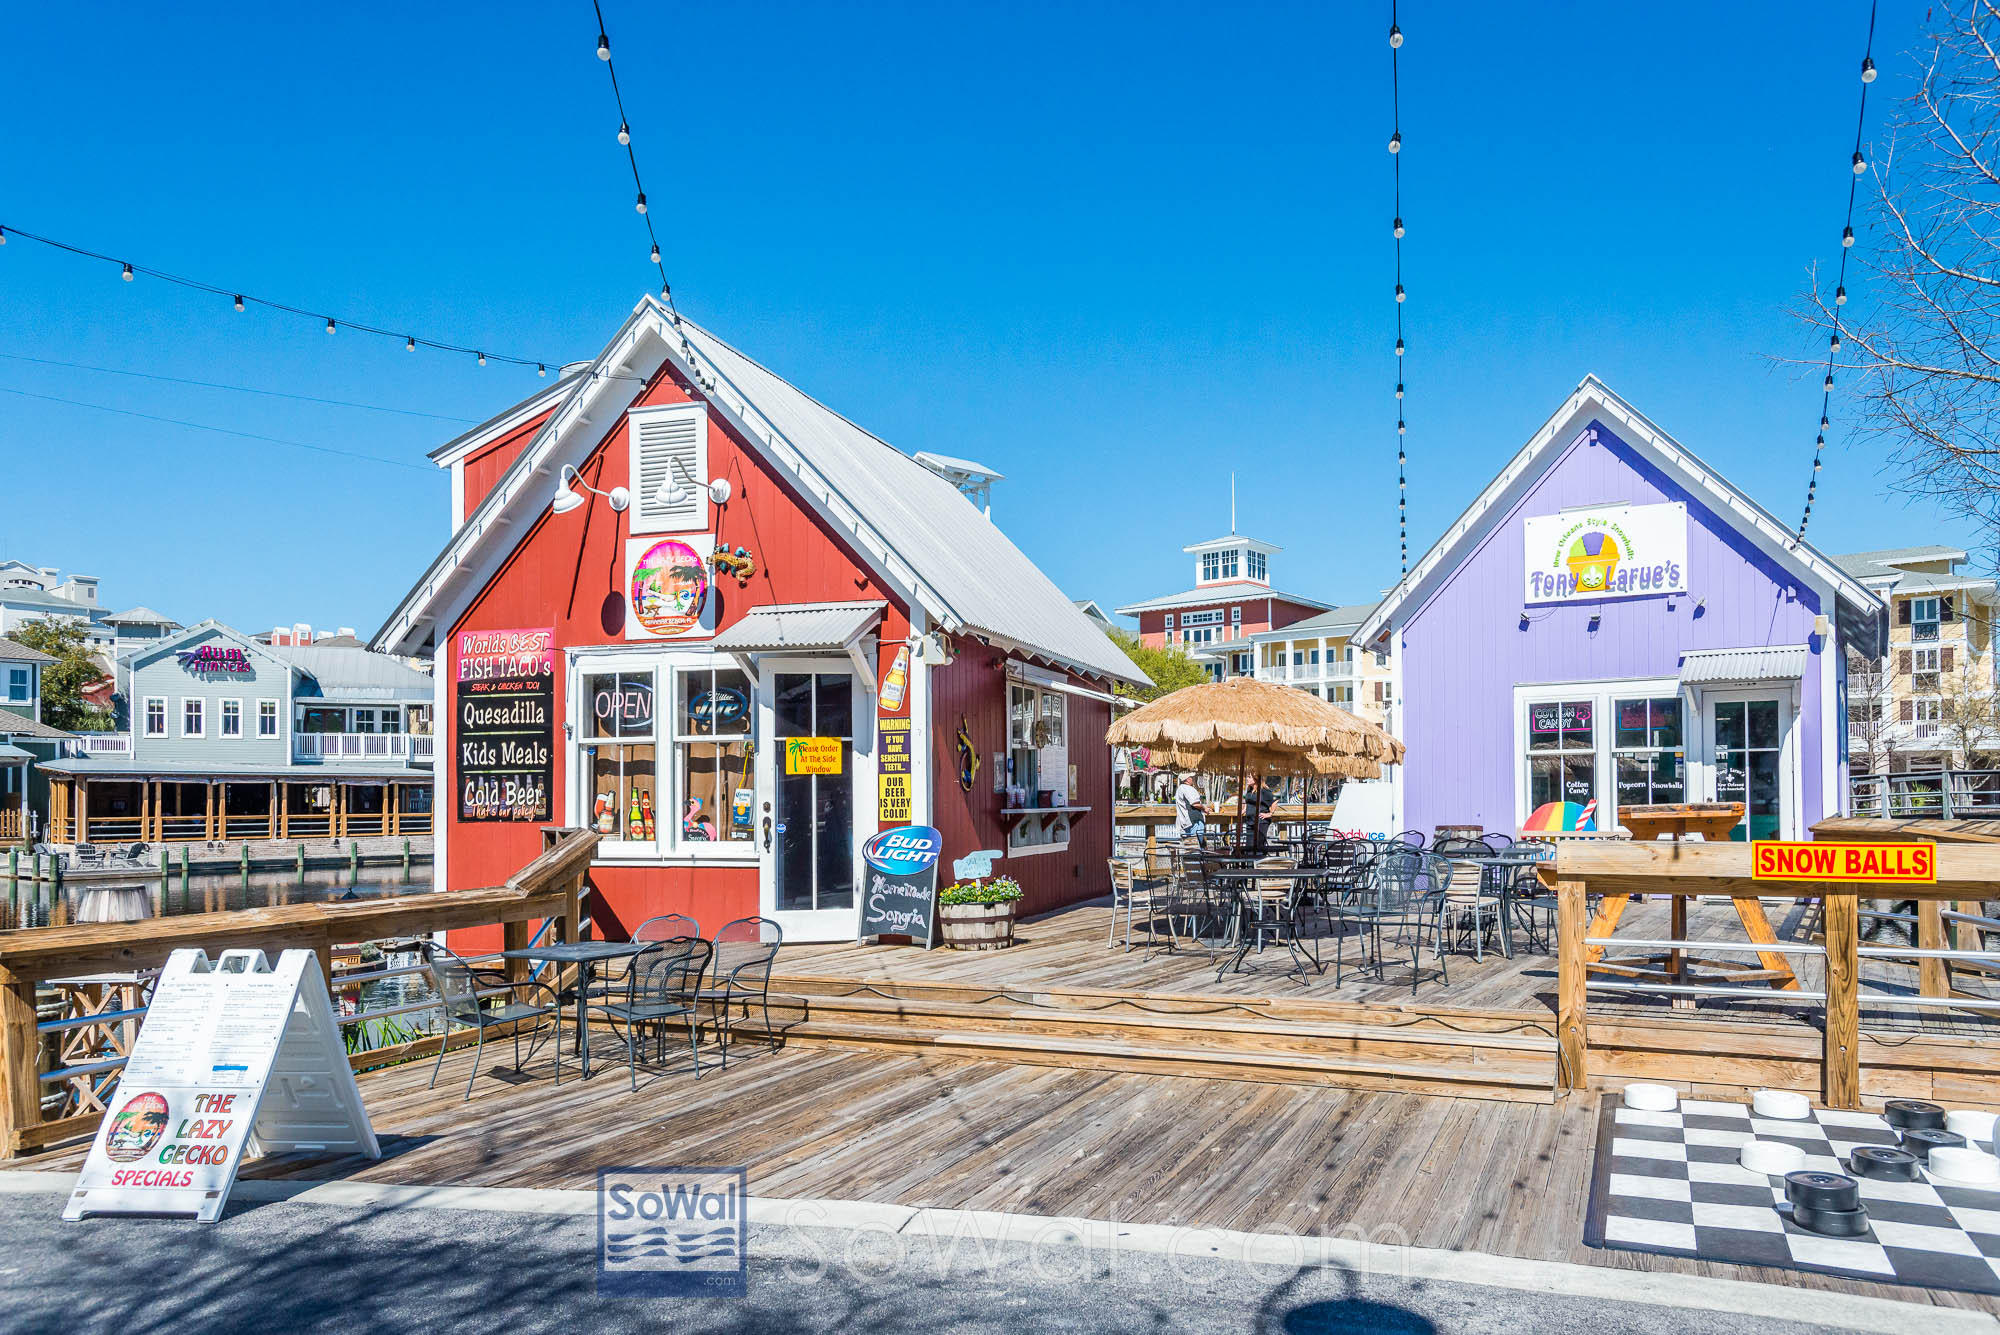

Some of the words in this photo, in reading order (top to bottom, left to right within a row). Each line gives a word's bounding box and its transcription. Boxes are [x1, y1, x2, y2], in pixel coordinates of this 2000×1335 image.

[1553, 550, 1561, 567] New
[1559, 523, 1583, 547] Orleans
[1587, 518, 1607, 527] Style
[1611, 523, 1634, 560] Snowballs
[1531, 571, 1579, 595] Tony
[1606, 560, 1680, 588] Larue's
[462, 634, 506, 654] Worlds
[508, 632, 550, 654] BEST
[202, 645, 242, 660] Rum
[460, 656, 494, 679] FISH
[498, 654, 551, 677] TACO's
[471, 683, 491, 692] STEAK
[497, 682, 523, 690] CHICKEN
[525, 681, 540, 690] TOO!
[707, 690, 735, 702] Miller
[595, 692, 652, 719] OPEN
[464, 701, 545, 729] Quesadilla
[1535, 708, 1575, 719] COTTON
[879, 719, 911, 731] WARNING
[1539, 718, 1572, 729] CANDY
[885, 736, 892, 744] IF
[892, 735, 904, 743] YOU
[462, 741, 496, 765] Kids
[501, 741, 547, 765] Meals
[888, 744, 902, 753] HAVE
[880, 754, 910, 763] SENSITIVE
[887, 777, 903, 786] OUR
[1619, 782, 1646, 790] Popcorn
[464, 780, 500, 806] Cold
[505, 781, 542, 806] Beer
[885, 788, 905, 797] BEER
[1568, 788, 1589, 796] Candy
[880, 799, 888, 808] IS
[891, 798, 911, 808] VERY
[472, 803, 497, 817] That's
[499, 807, 512, 817] our
[512, 803, 537, 822] policy!
[884, 809, 908, 819] COLD!
[885, 835, 932, 850] BUD
[873, 850, 937, 862] LIGHT
[1760, 848, 1836, 874] SNOW
[1846, 849, 1928, 875] BALLS
[866, 894, 926, 931] Sangria
[195, 1094, 237, 1113] THE
[176, 1119, 233, 1138] LAZY
[159, 1144, 228, 1165] GECKO
[111, 1170, 194, 1187] SPECIALS
